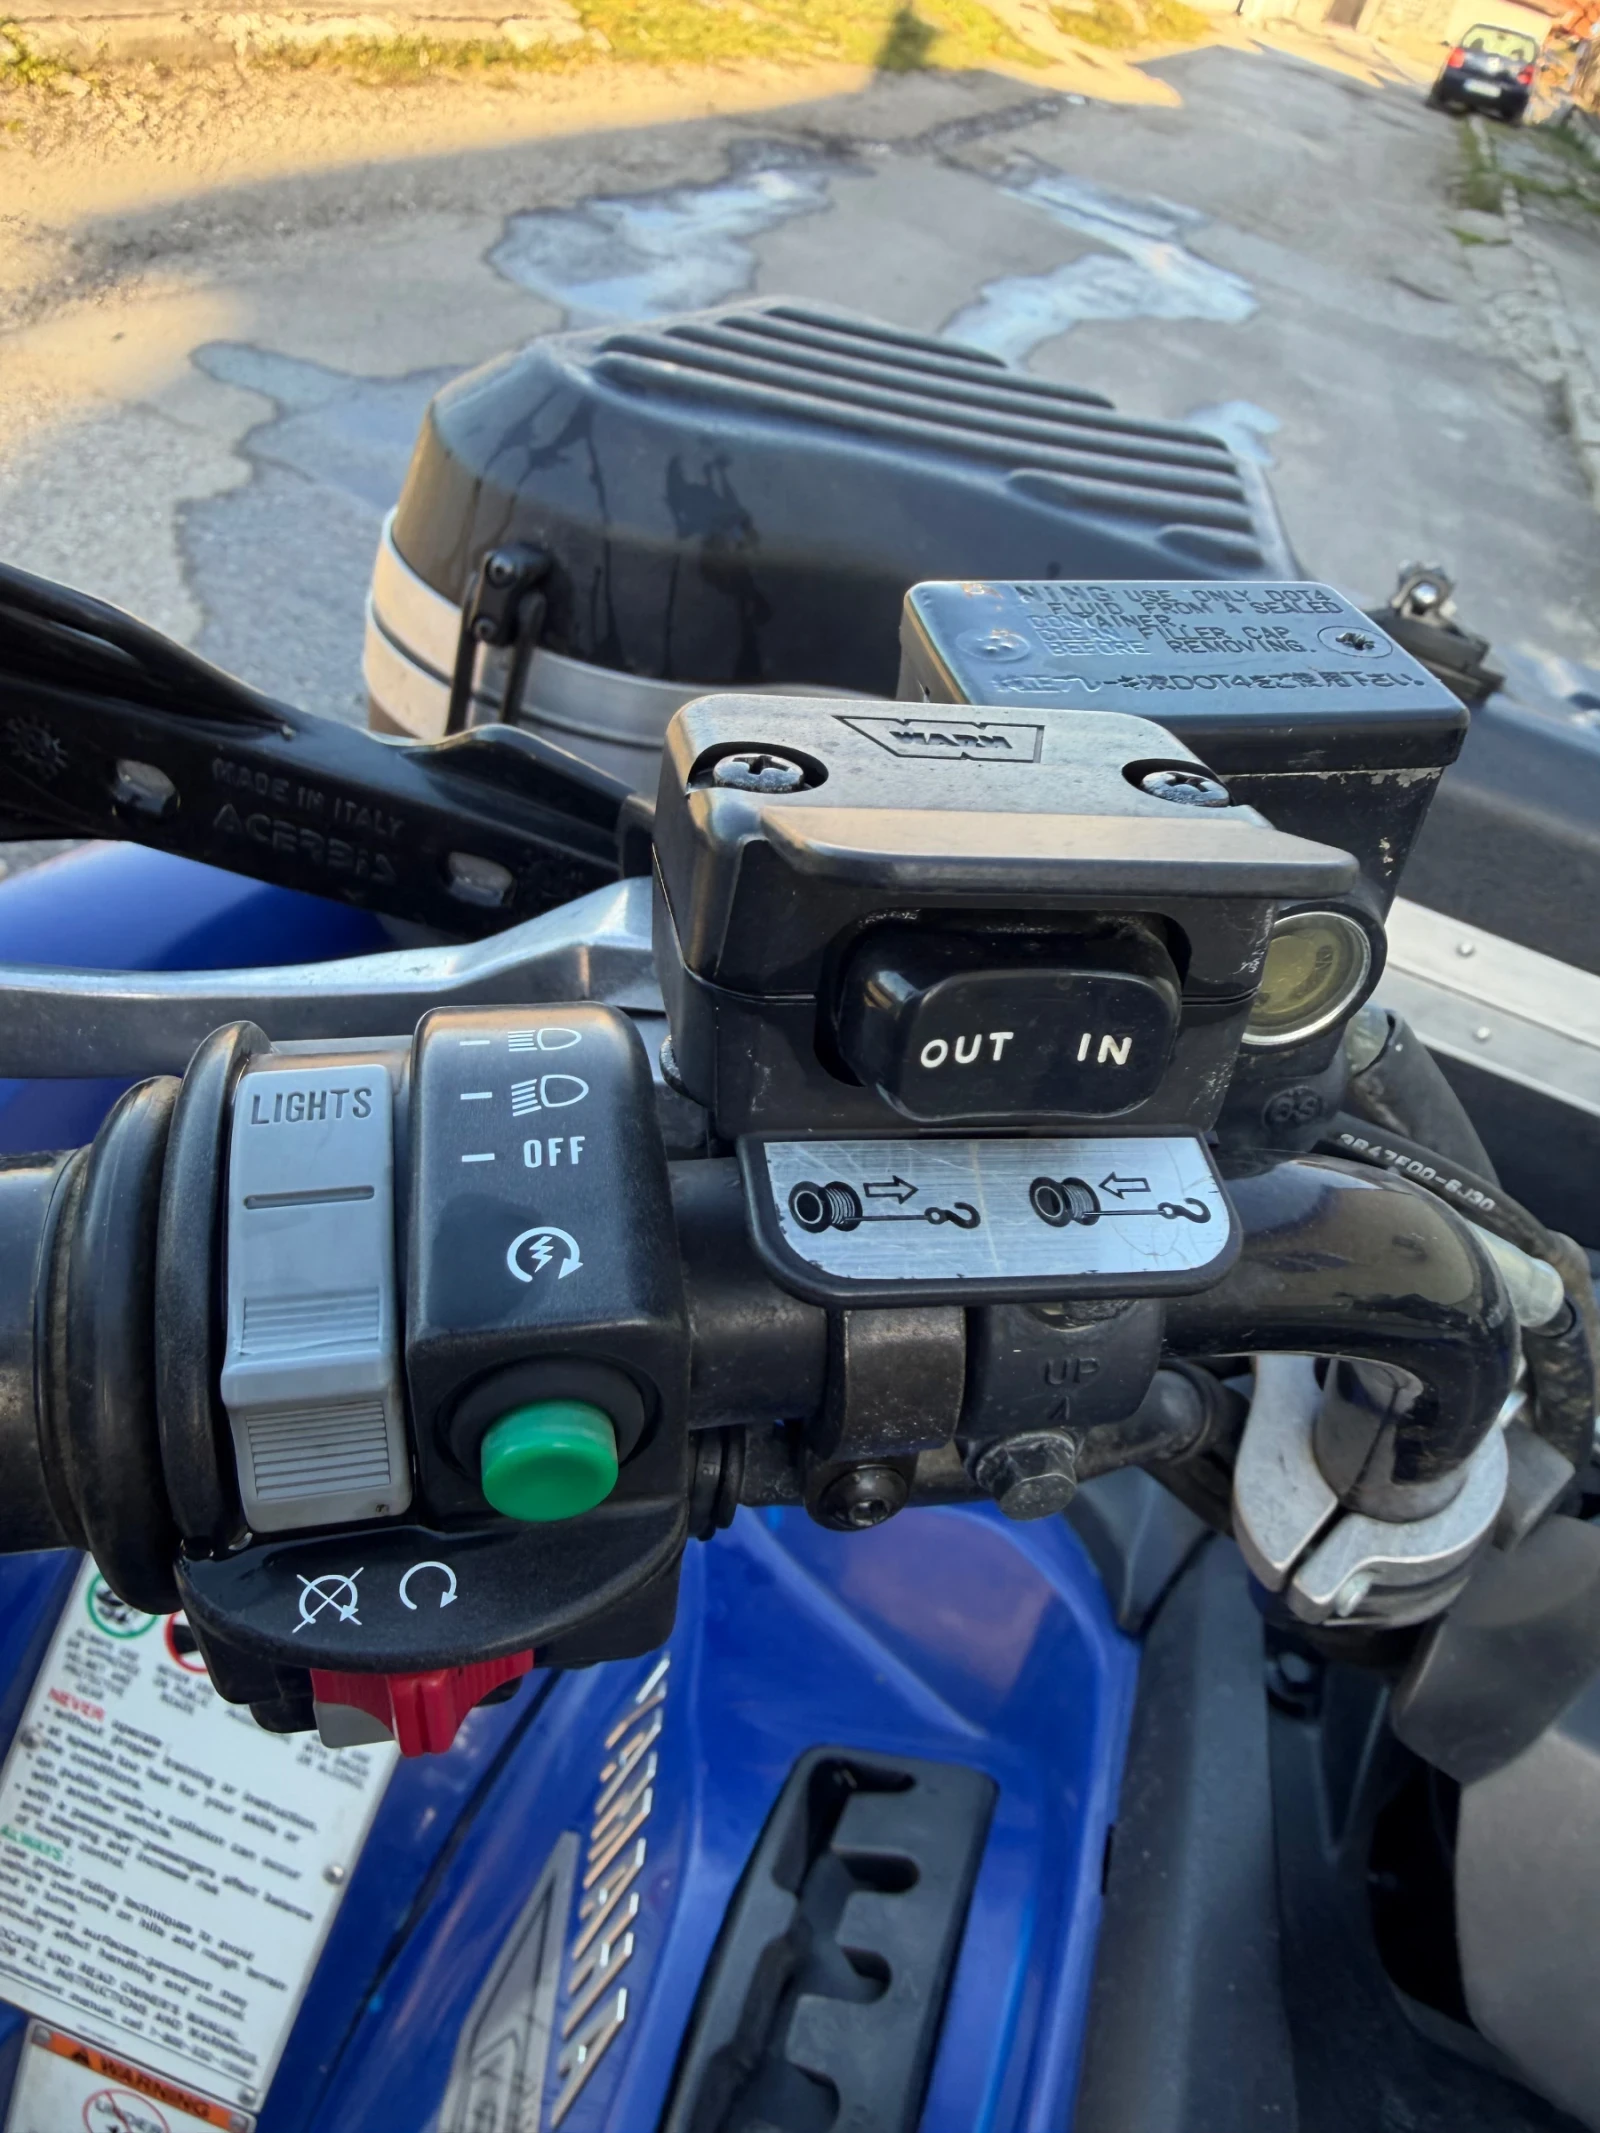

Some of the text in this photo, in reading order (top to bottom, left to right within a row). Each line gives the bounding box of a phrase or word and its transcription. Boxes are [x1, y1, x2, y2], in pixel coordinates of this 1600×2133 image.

[1047, 601, 1344, 616] FLUID FROM A SEALED
[1122, 589, 1178, 603] USE
[1191, 589, 1249, 602] ONLY
[1264, 589, 1331, 602] DOT4
[1046, 640, 1152, 657] BEFORE
[1138, 626, 1232, 641] FILLER
[1241, 626, 1292, 640] CAP
[211, 756, 405, 840] MADE IN ITALY
[920, 1031, 1132, 1068] OUT IN
[250, 1087, 373, 1126] LIGHTS
[522, 1135, 586, 1168] OFF
[1042, 1356, 1100, 1386] UP
[46, 1685, 107, 1723] NEVER
[549, 1650, 672, 2131] YAMAHA
